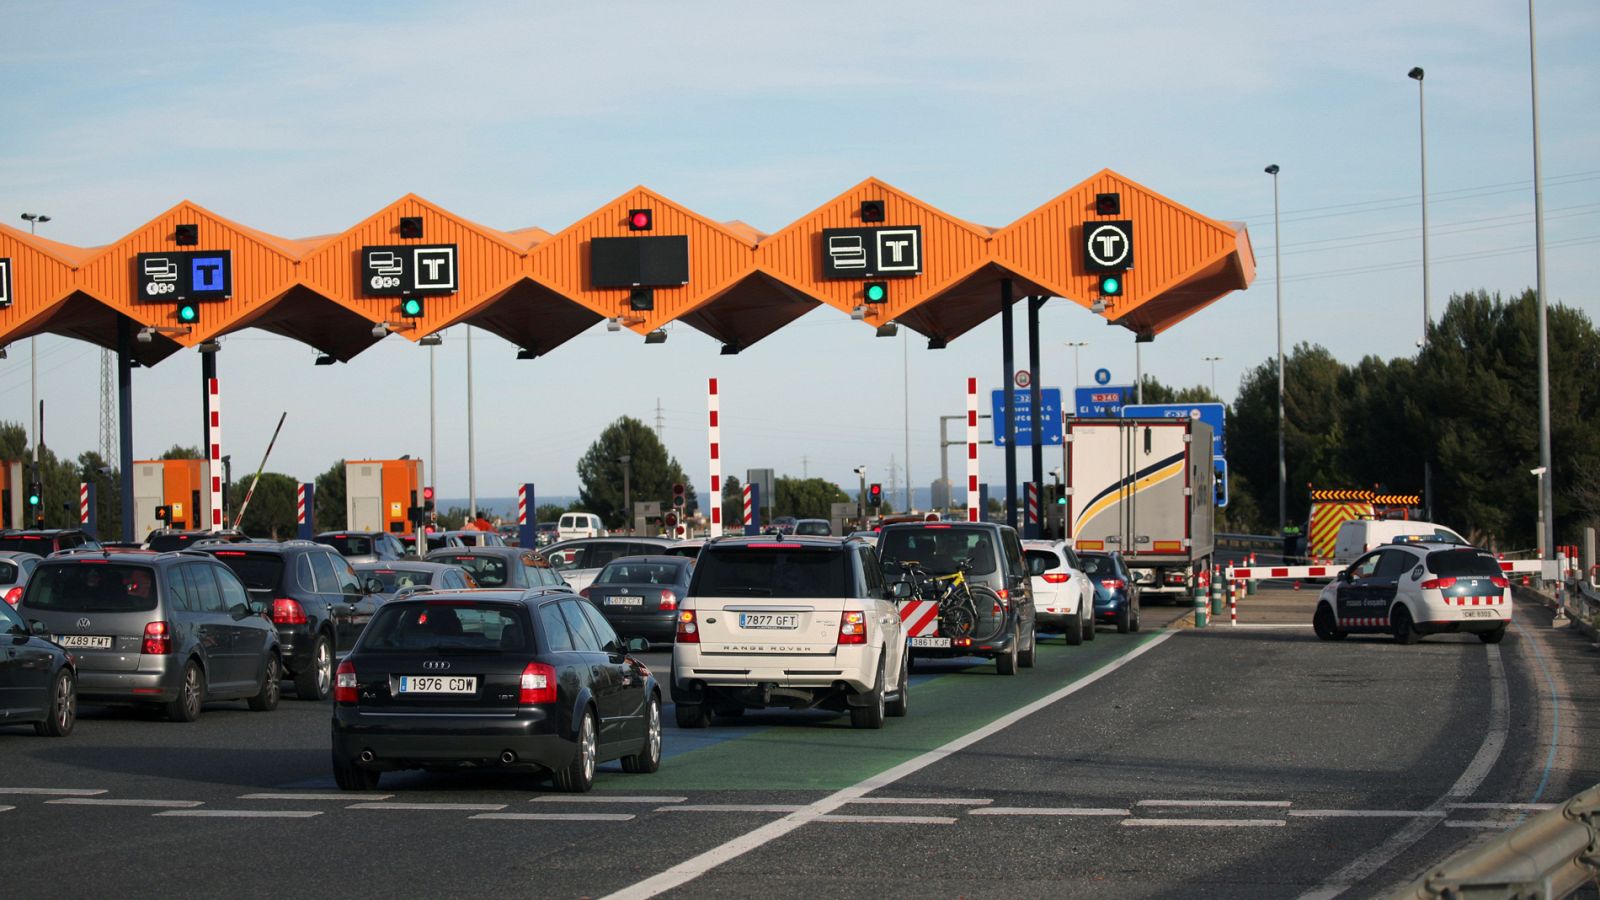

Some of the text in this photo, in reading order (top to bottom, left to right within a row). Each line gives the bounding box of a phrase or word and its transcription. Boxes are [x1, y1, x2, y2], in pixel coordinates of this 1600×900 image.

[747, 615, 796, 626] 7877 GFT
[65, 637, 110, 646] 7489 FMT
[413, 678, 474, 691] 1976 CDW
